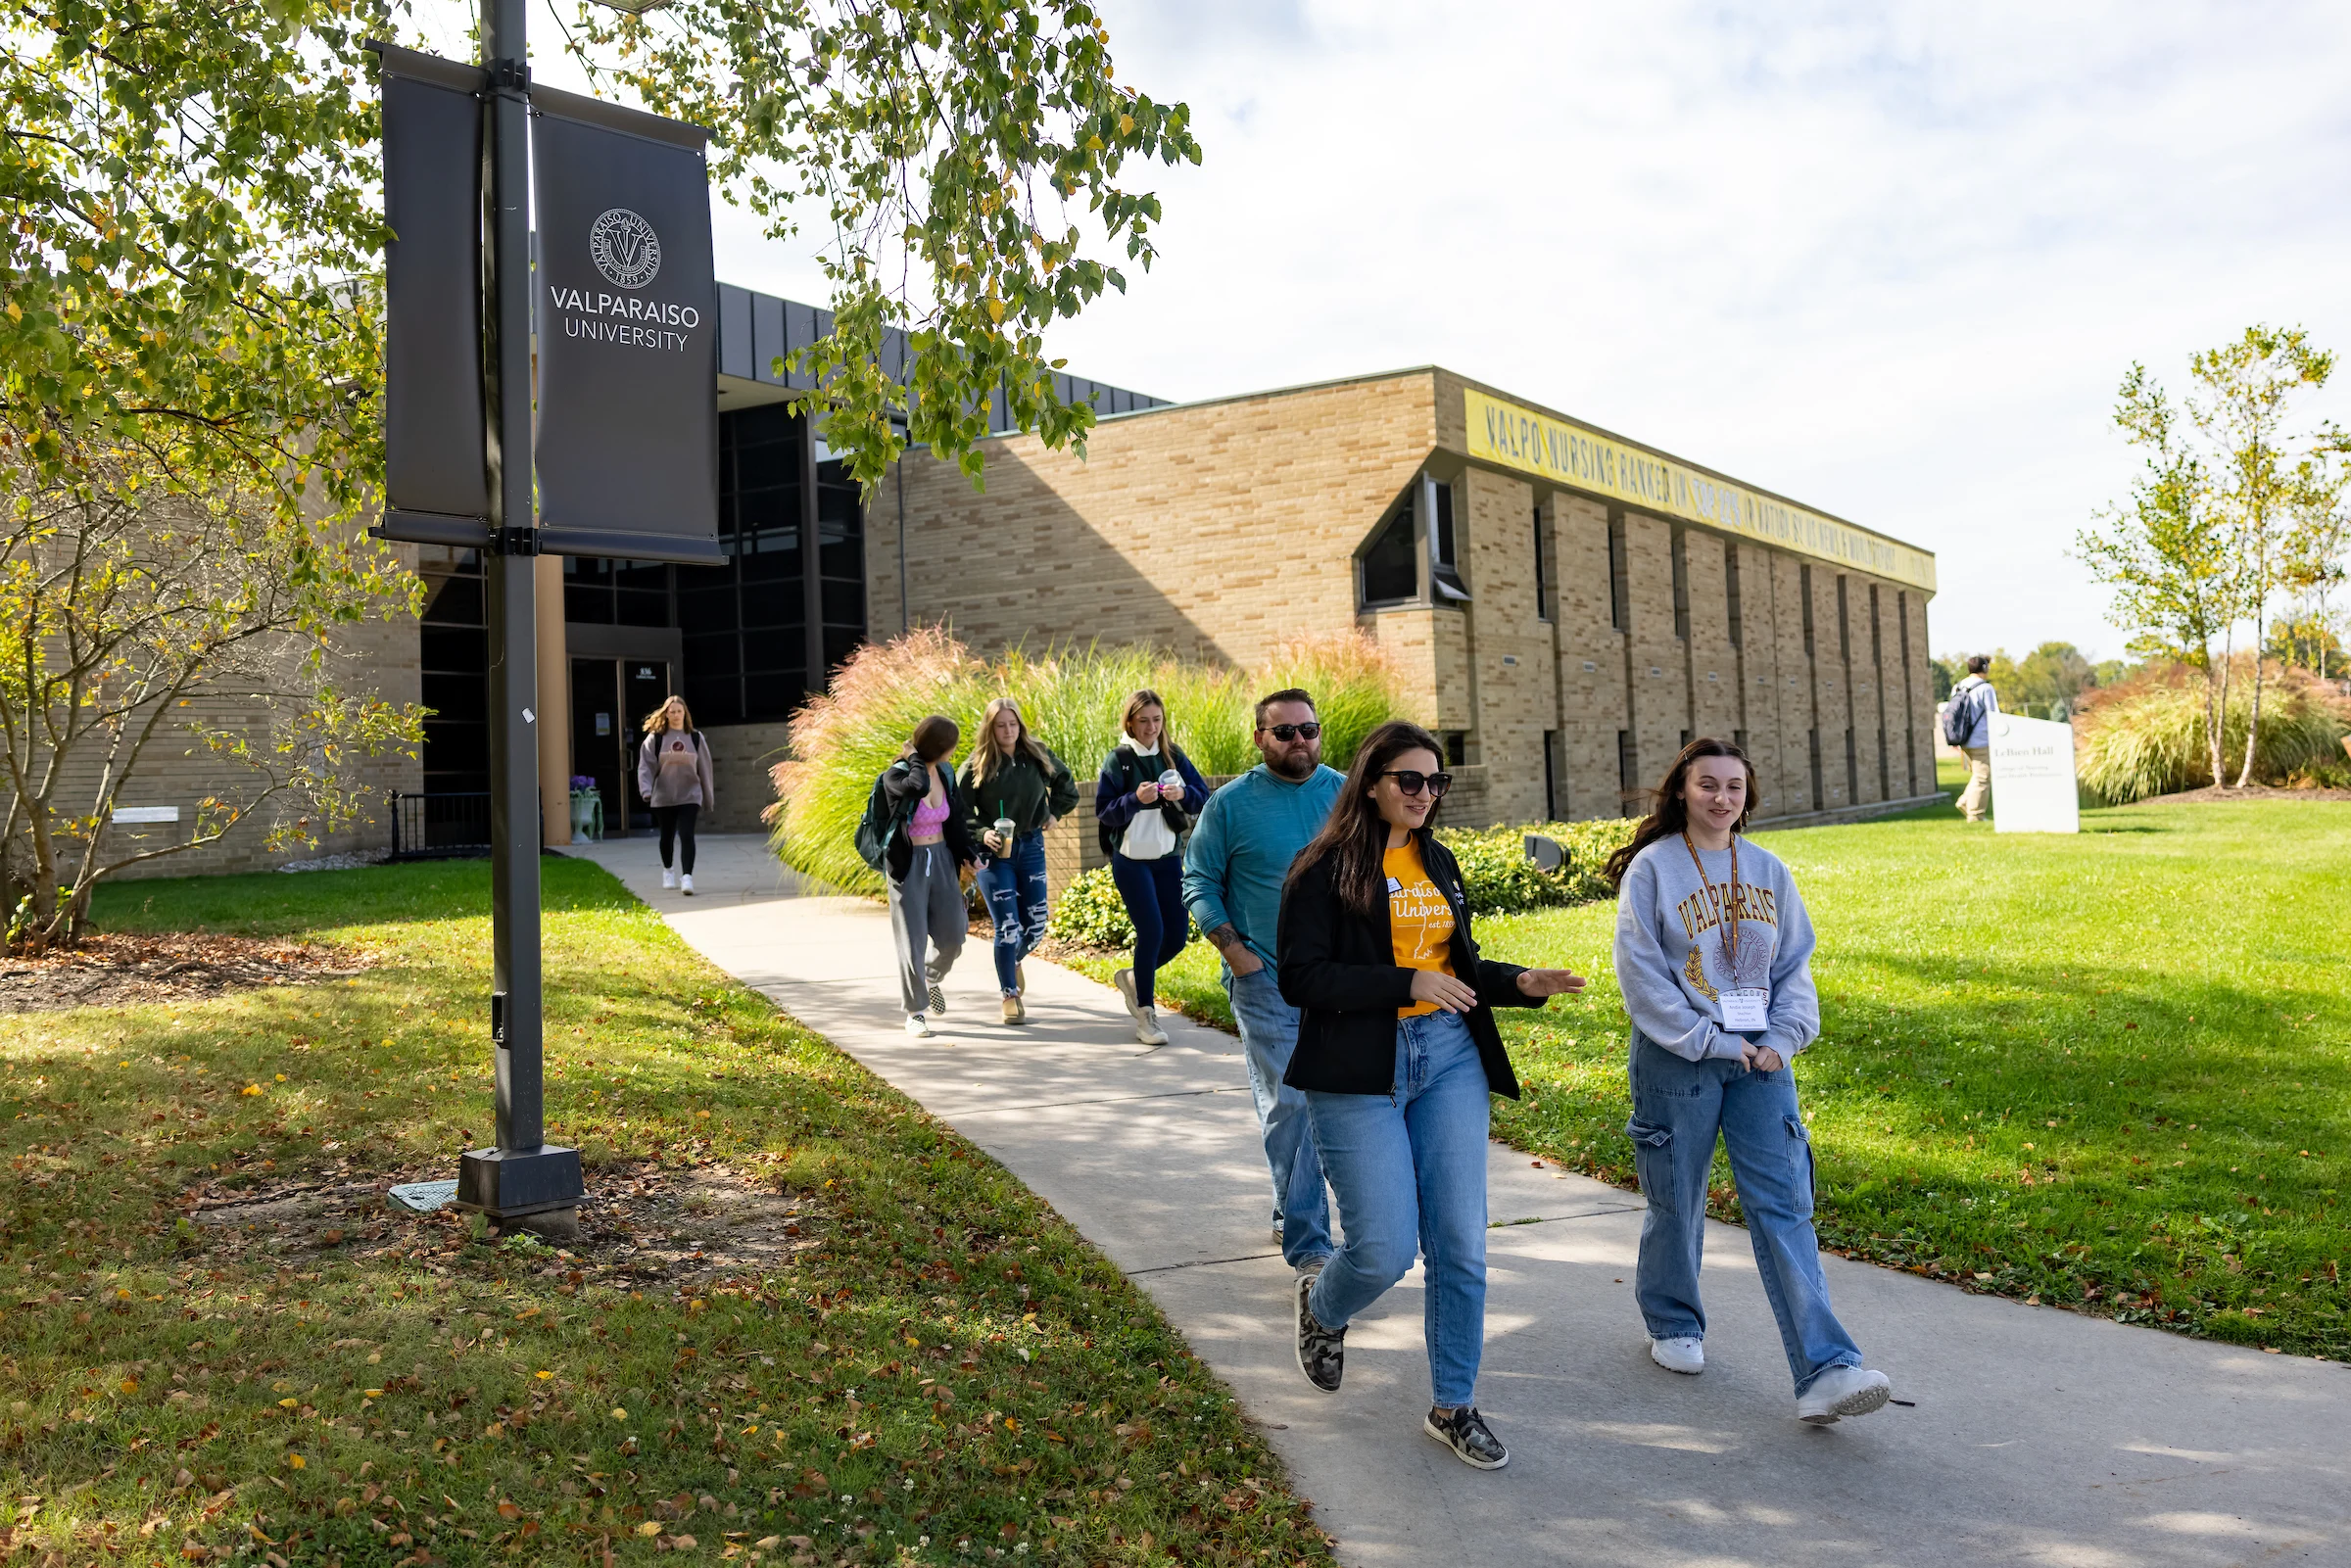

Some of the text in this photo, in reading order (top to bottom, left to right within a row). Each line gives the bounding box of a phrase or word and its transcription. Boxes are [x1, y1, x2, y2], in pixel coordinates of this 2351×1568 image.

[593, 213, 622, 271] VALPARAISO
[629, 215, 657, 279] UNIVERSITY
[614, 273, 639, 285] 1859
[551, 286, 699, 328] VALPARAISO
[565, 318, 689, 352] UNIVERSITY
[1485, 404, 1541, 464] VALPO
[1549, 427, 1613, 487] NURSING
[1620, 453, 1670, 502] RANKED
[1674, 471, 1688, 508] IN
[1693, 478, 1717, 522] TOP
[1717, 486, 1741, 527] 22%
[2033, 745, 2054, 756] Hall
